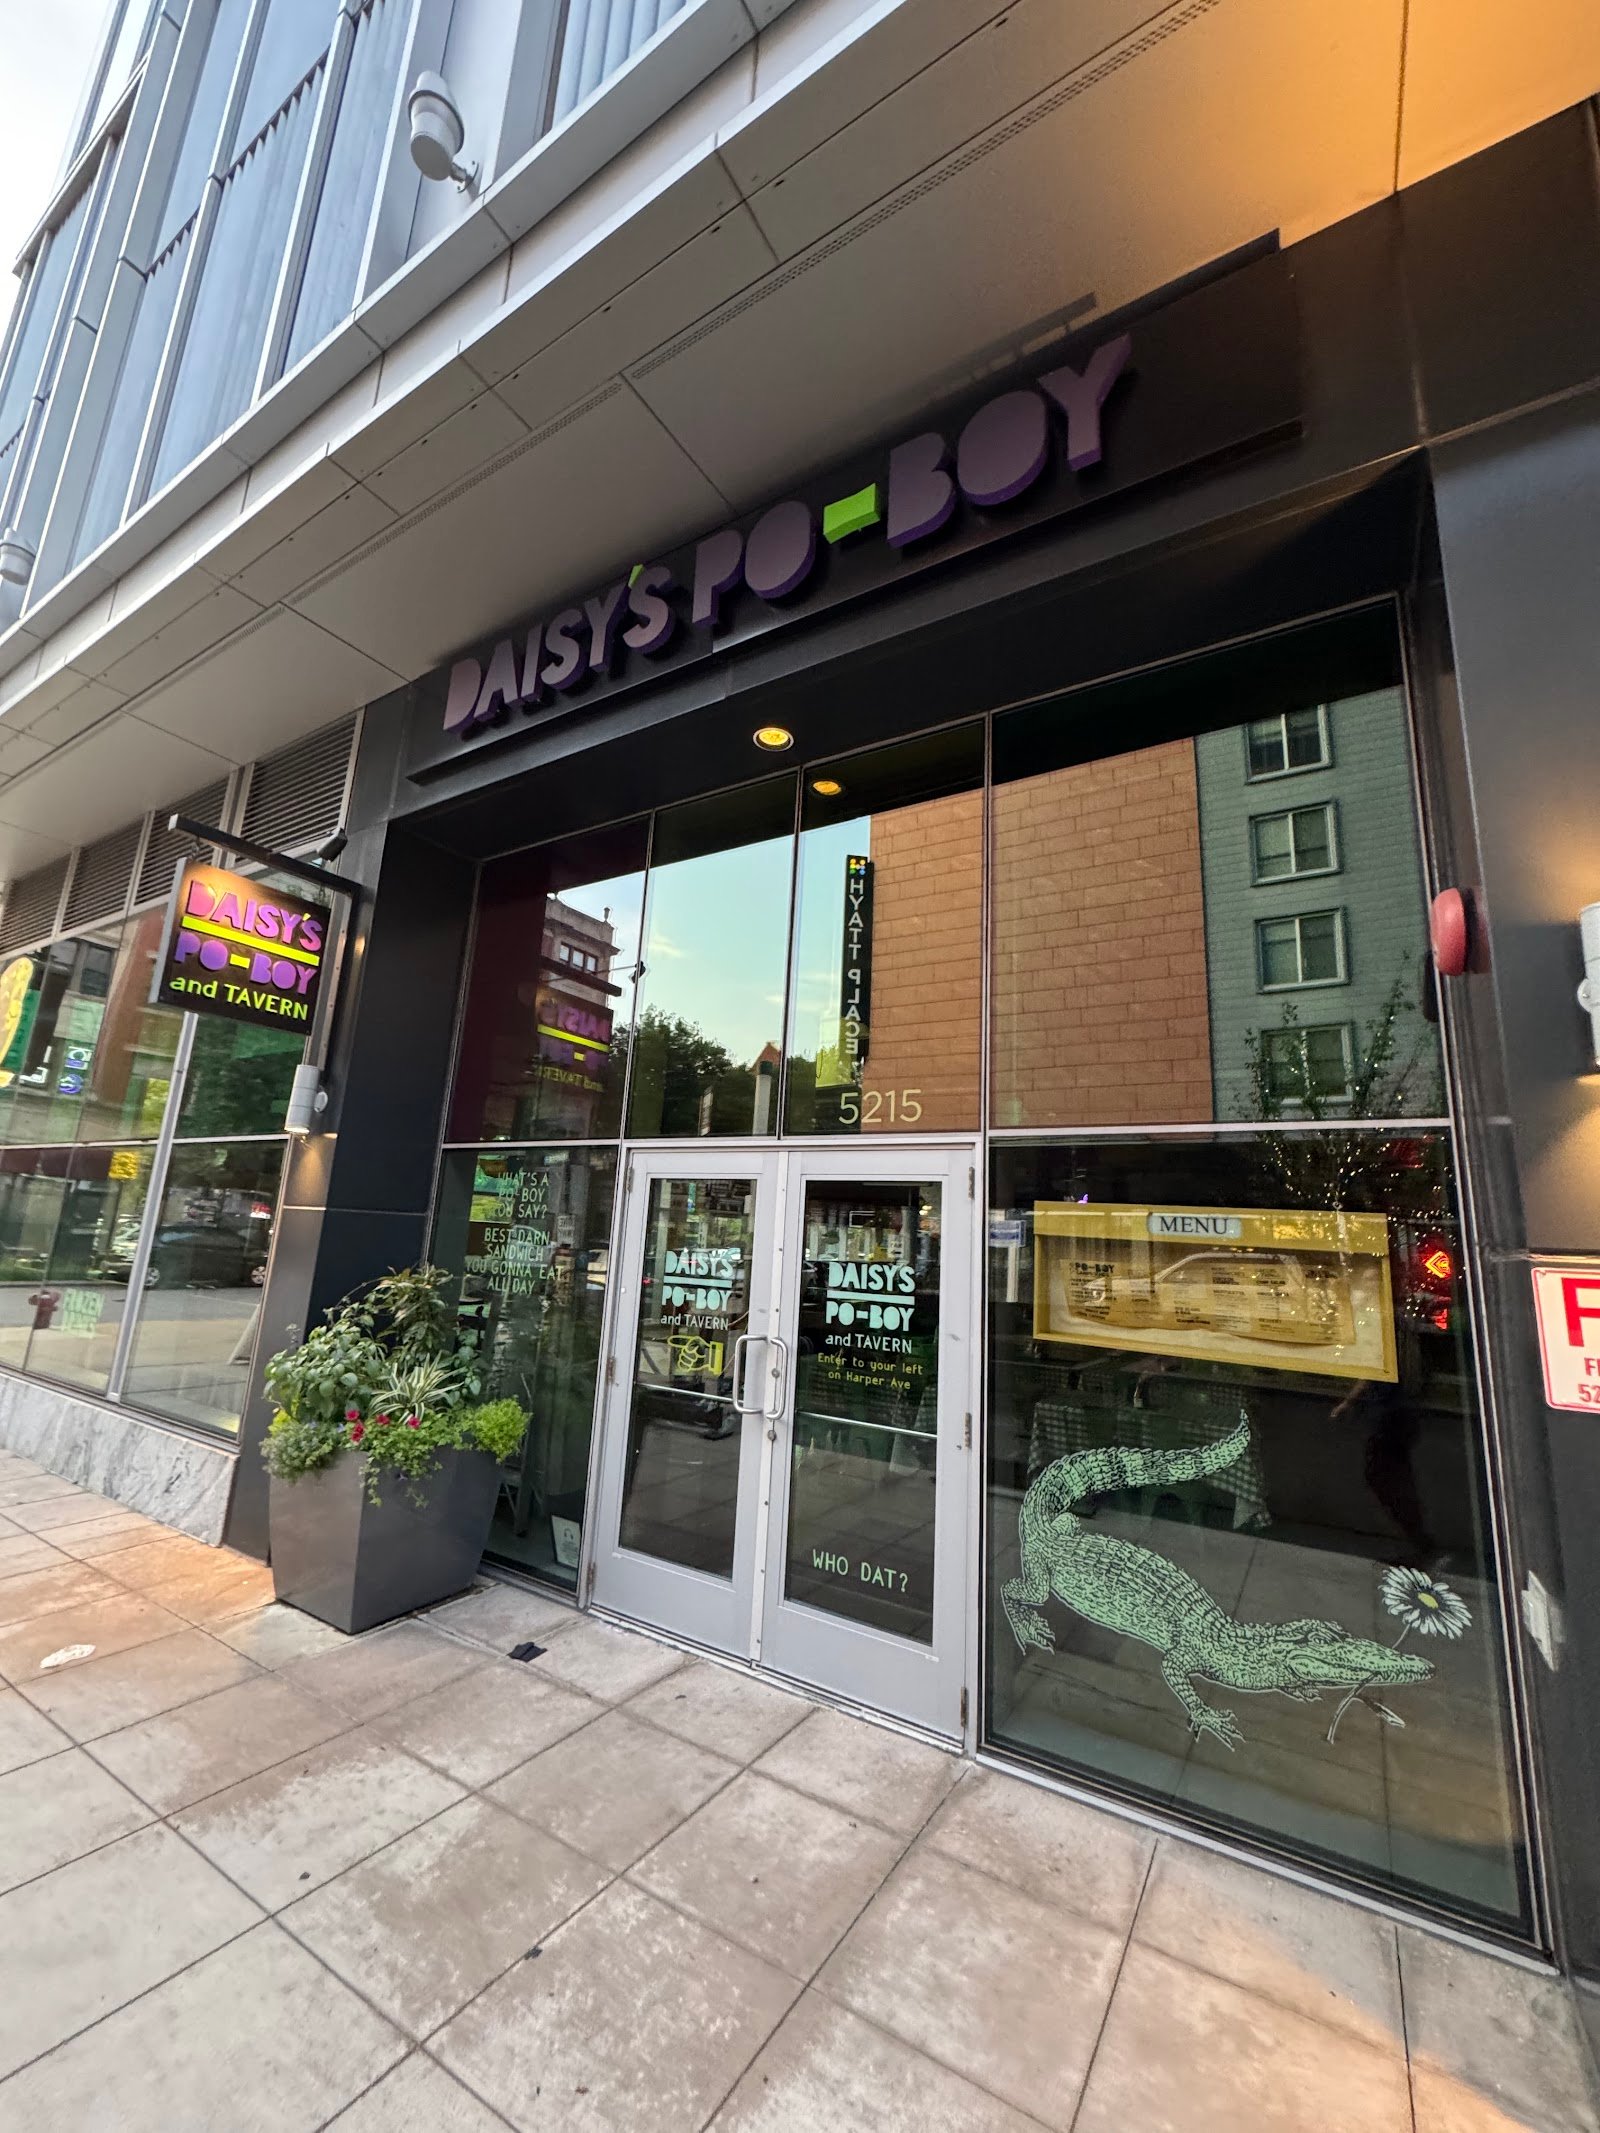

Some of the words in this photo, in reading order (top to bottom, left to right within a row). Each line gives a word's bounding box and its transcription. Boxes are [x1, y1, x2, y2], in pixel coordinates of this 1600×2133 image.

[443, 563, 677, 732] DAISY'S
[692, 333, 1132, 626] PO-BOY
[185, 880, 323, 952] DAISY'S
[174, 931, 317, 995] PO-BOY
[169, 977, 218, 998] and
[224, 984, 308, 1021] TAVERN
[838, 1088, 922, 1125] 5215
[540, 1172, 550, 1188] A
[518, 1203, 548, 1219] SAY?
[484, 1227, 514, 1242] BEST
[518, 1231, 550, 1246] DARN
[1158, 1215, 1229, 1235] MENU
[486, 1243, 544, 1262] SANDWICH
[465, 1257, 487, 1274] YOU
[490, 1260, 532, 1278] GONNA
[539, 1264, 564, 1281] EAT
[512, 1279, 536, 1295] DAY
[661, 1285, 732, 1312] PO-BOY
[660, 1313, 682, 1325] and
[684, 1313, 729, 1331] TAVERN
[825, 1300, 915, 1332] PO-BOY
[825, 1333, 852, 1347] and
[855, 1333, 912, 1354] TAVERN
[817, 1352, 848, 1364] Enter
[852, 1356, 865, 1368] to
[870, 1361, 897, 1373] your
[902, 1362, 924, 1375] left
[828, 1371, 841, 1380] on
[846, 1370, 885, 1386] Harper
[890, 1378, 911, 1390] Ave
[812, 1548, 849, 1576] WHO
[860, 1561, 909, 1593] DAT?
